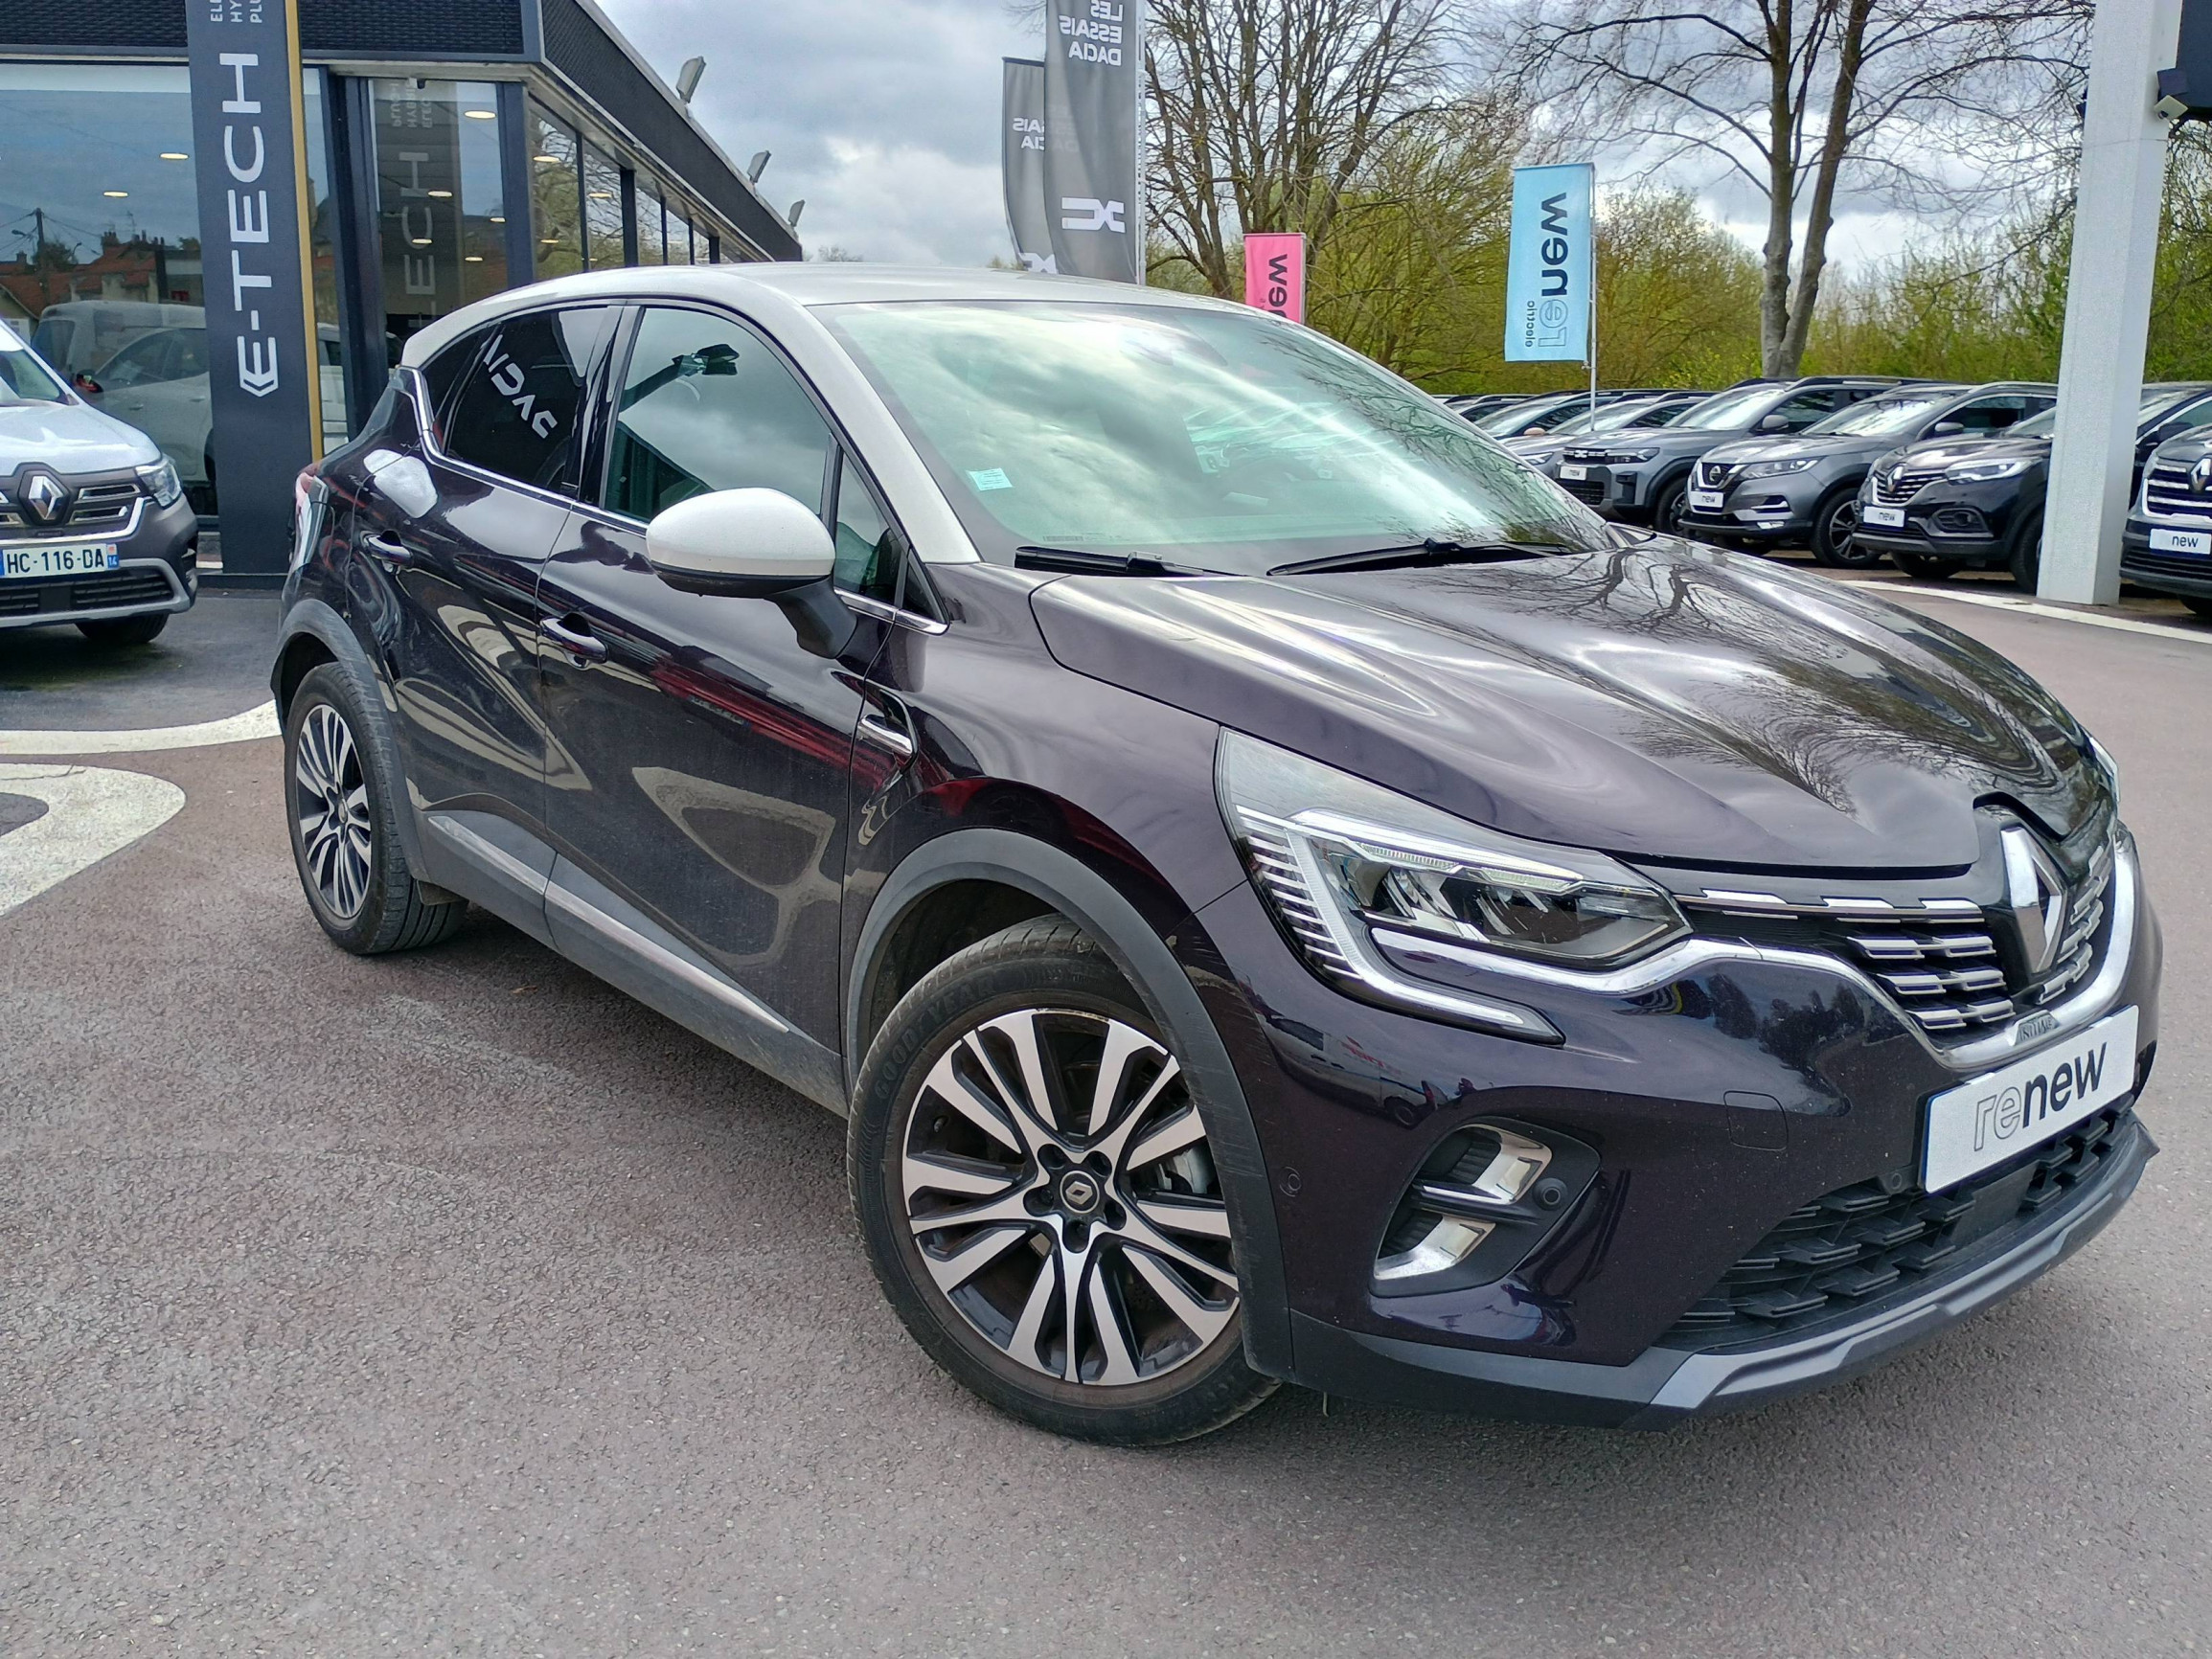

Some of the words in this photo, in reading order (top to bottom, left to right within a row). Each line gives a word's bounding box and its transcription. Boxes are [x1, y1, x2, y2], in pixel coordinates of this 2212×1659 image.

[219, 53, 279, 397] E-TECH
[7, 548, 104, 574] HC-116-DA
[2172, 535, 2199, 548] new
[1973, 1042, 2109, 1151] renew
